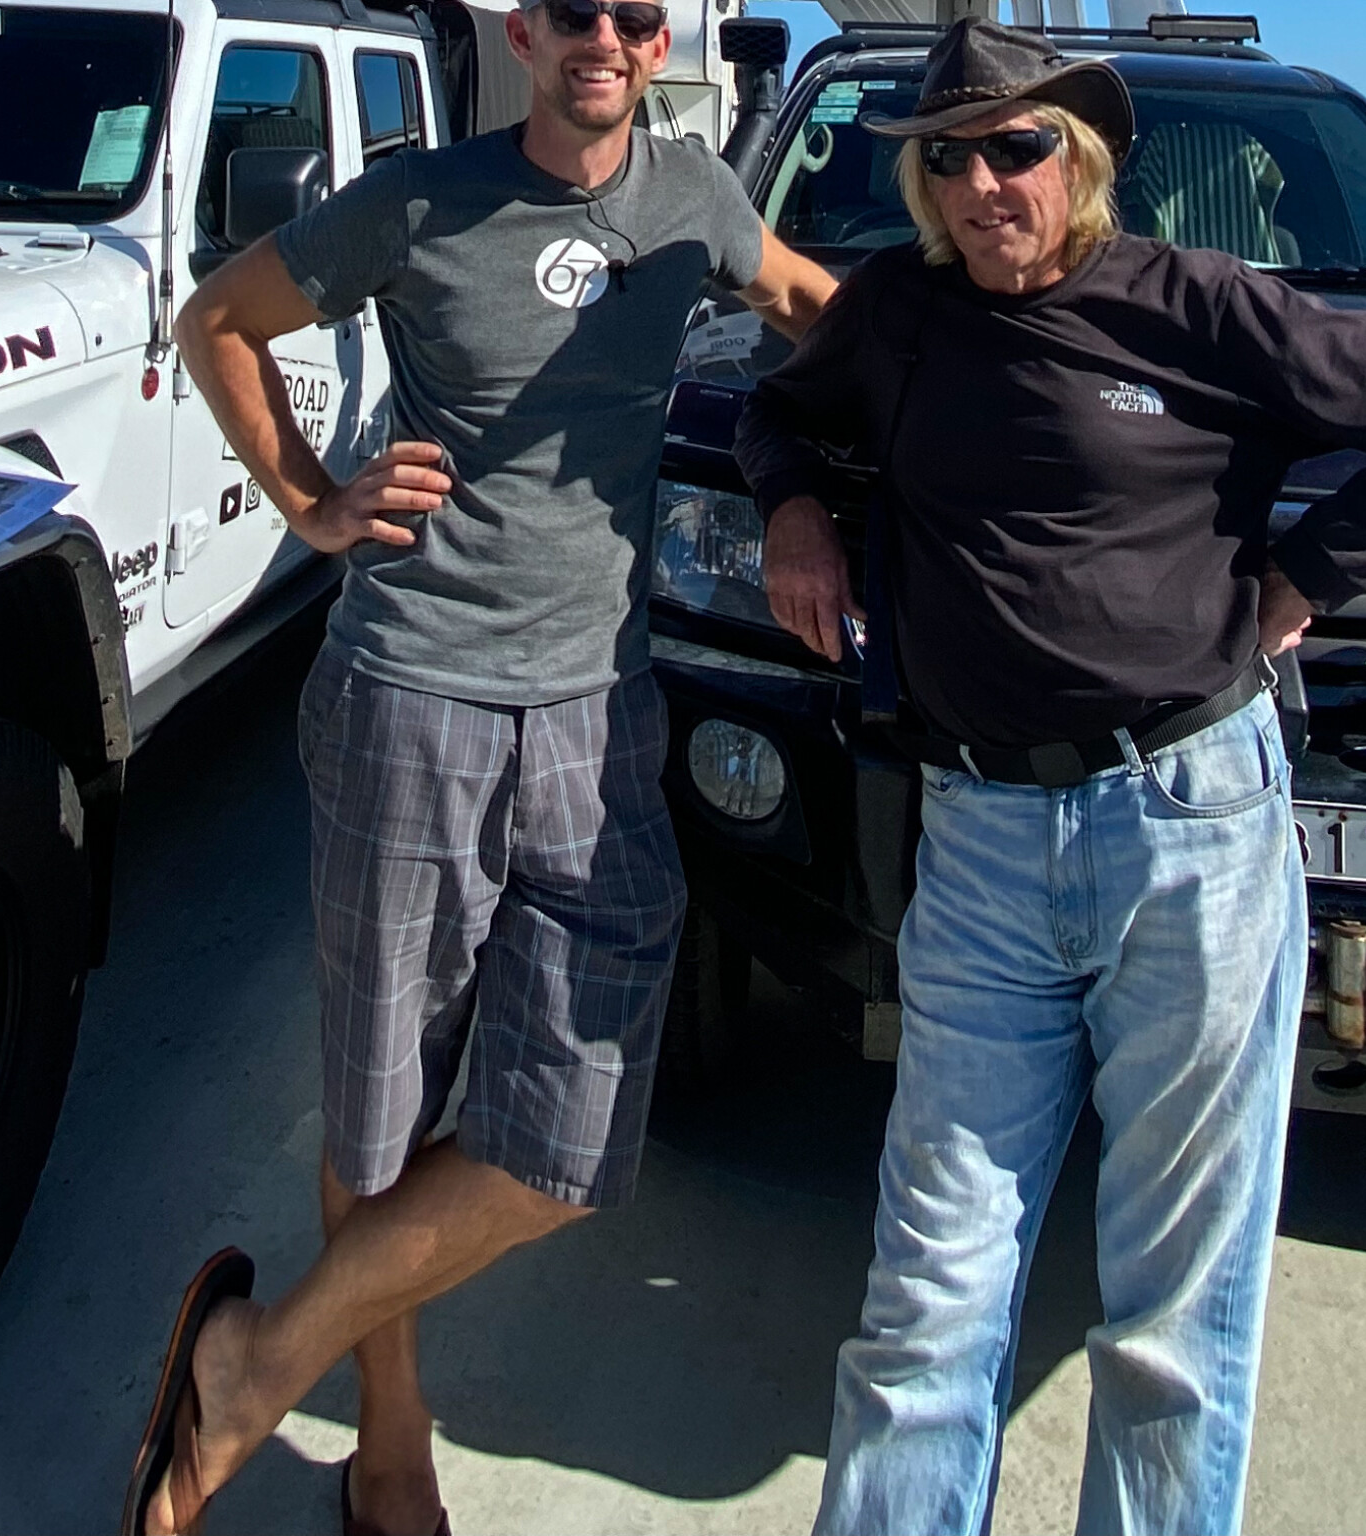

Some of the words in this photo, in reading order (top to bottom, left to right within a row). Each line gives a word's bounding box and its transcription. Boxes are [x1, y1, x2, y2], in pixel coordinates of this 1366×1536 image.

[1118, 381, 1140, 392] THE
[1099, 390, 1142, 403] NORTH
[1110, 399, 1142, 413] FACE
[111, 541, 158, 584] Jeep
[119, 576, 157, 602] DIATOR
